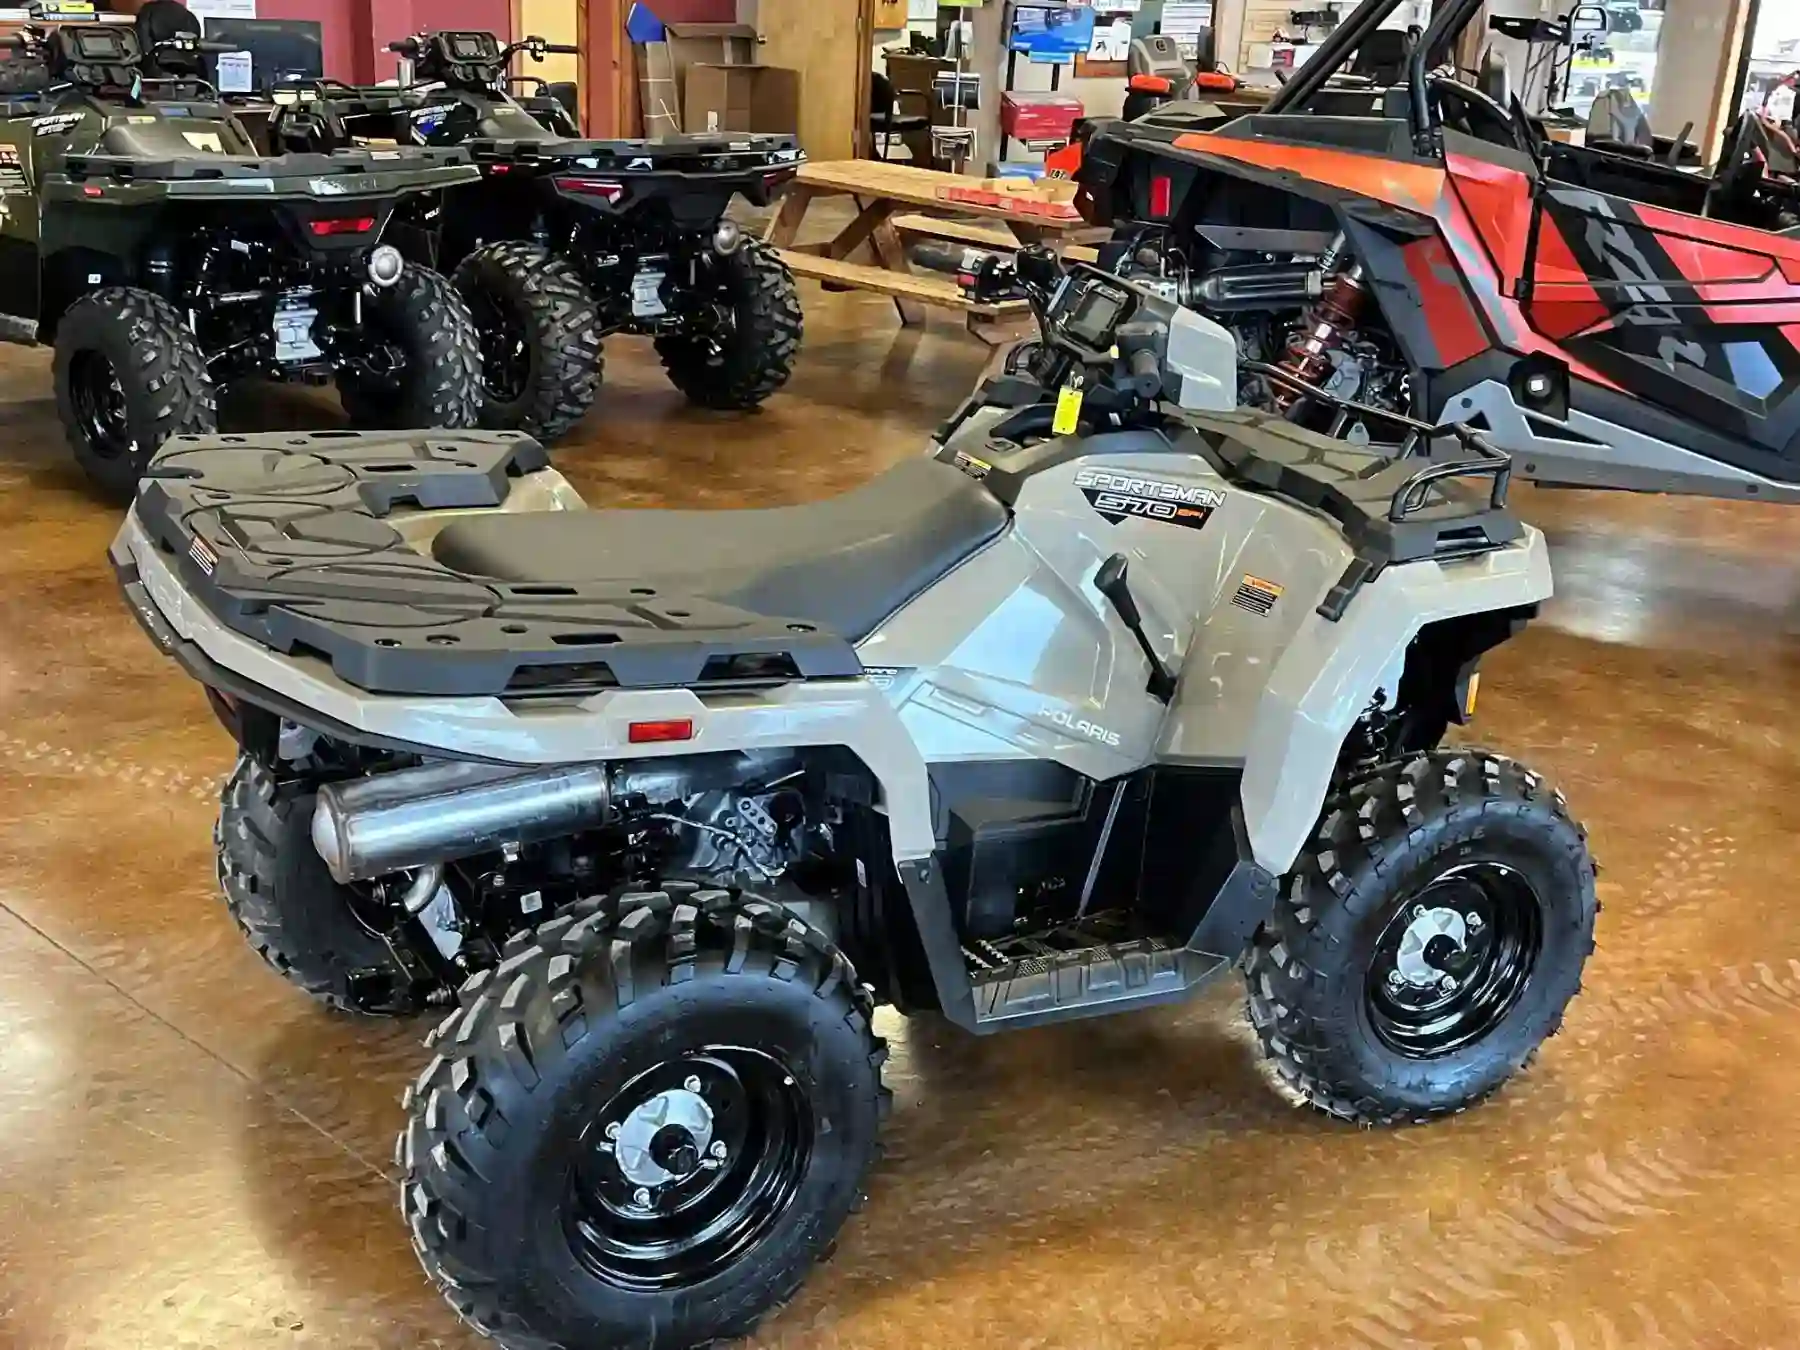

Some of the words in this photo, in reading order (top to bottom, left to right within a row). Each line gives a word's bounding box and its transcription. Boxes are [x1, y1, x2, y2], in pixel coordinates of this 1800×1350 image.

[1073, 470, 1227, 507] SPORTSMAN
[1094, 492, 1178, 519] 570
[1037, 703, 1121, 746] POLARIS
